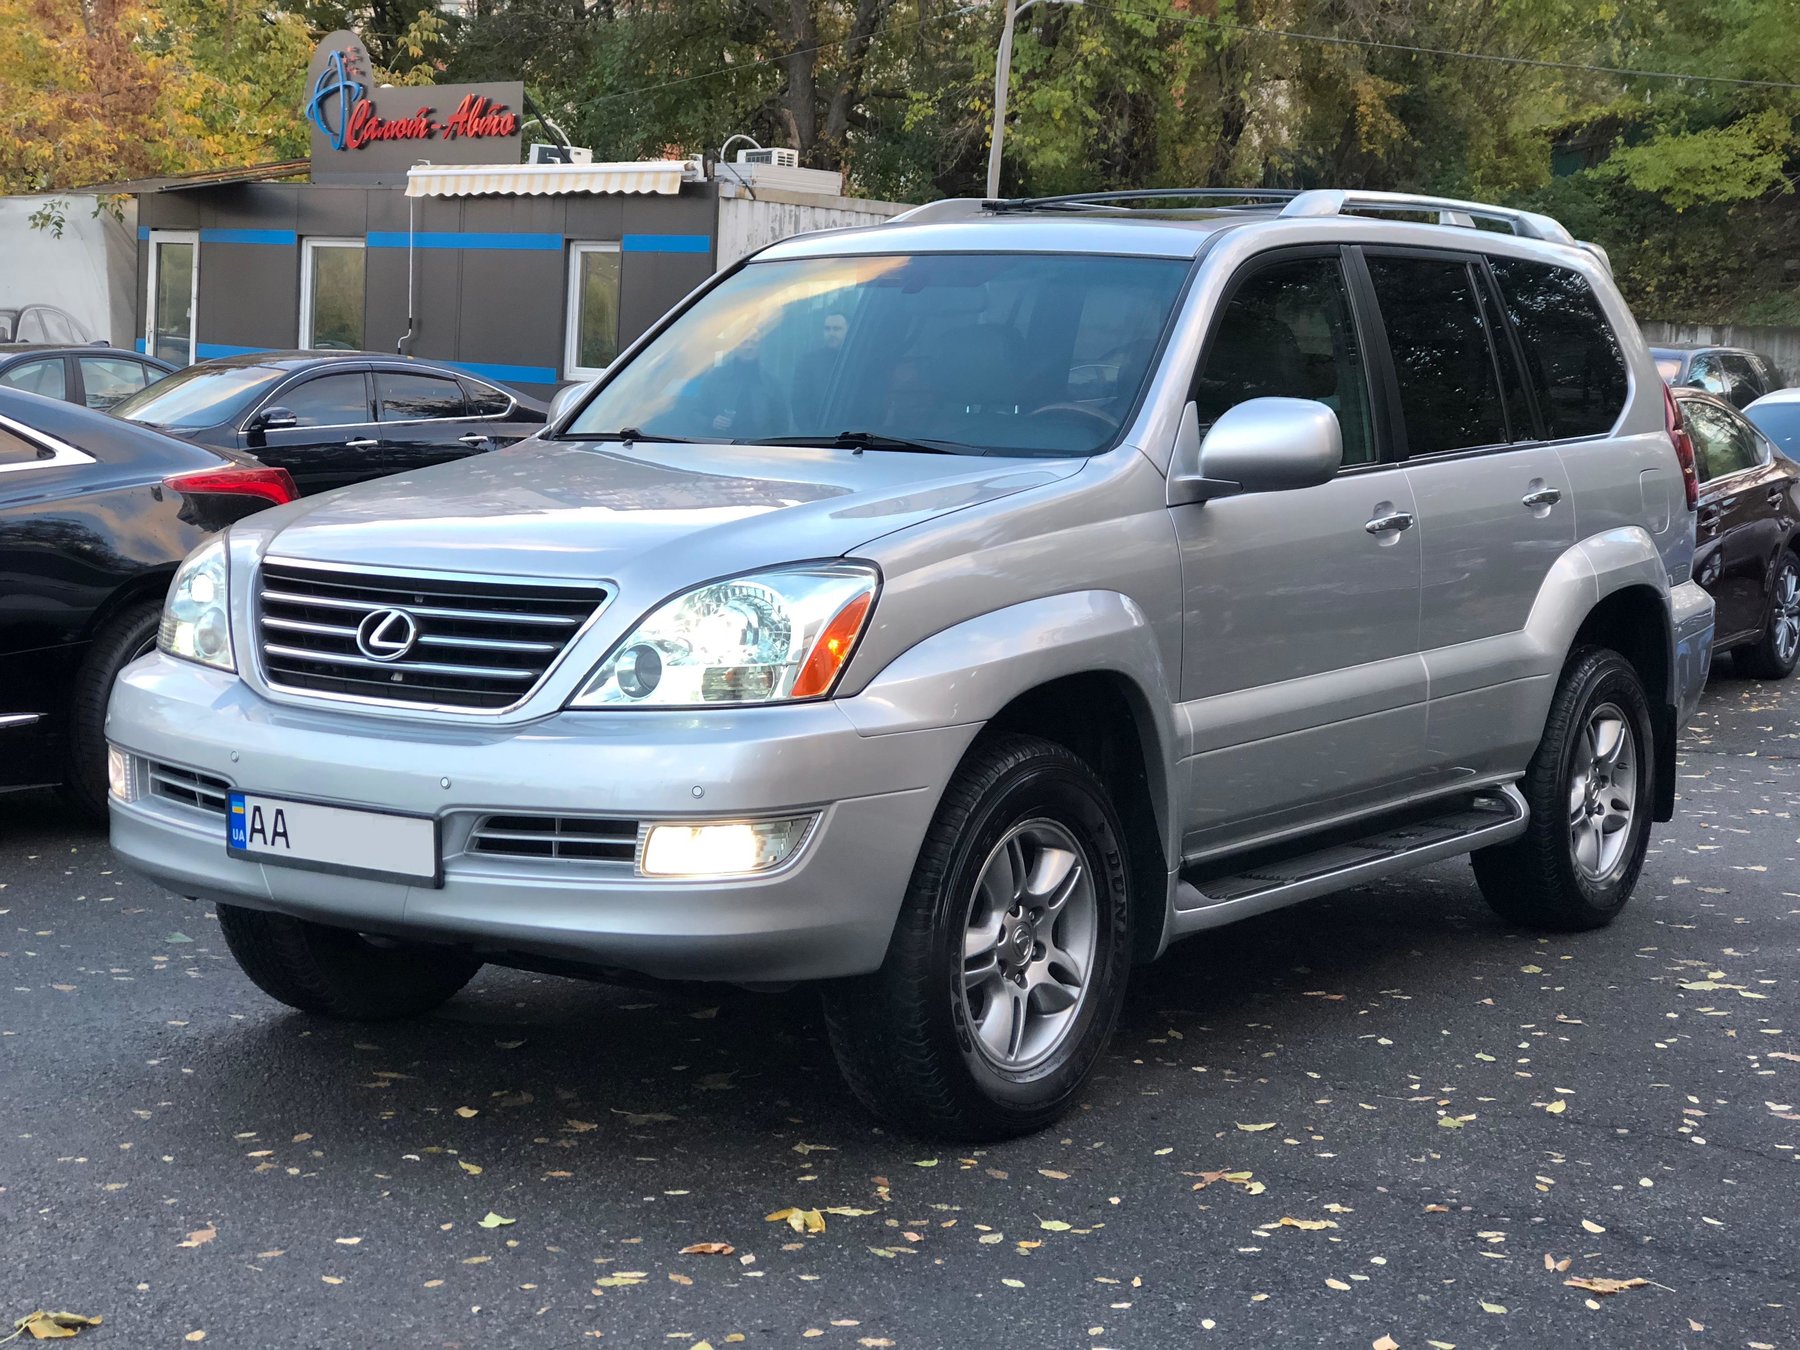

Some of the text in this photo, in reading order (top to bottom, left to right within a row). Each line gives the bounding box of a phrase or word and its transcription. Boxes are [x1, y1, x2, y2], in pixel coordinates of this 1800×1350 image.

[346, 93, 515, 149] Салют-Авто
[232, 828, 245, 842] UA
[249, 805, 291, 848] AA
